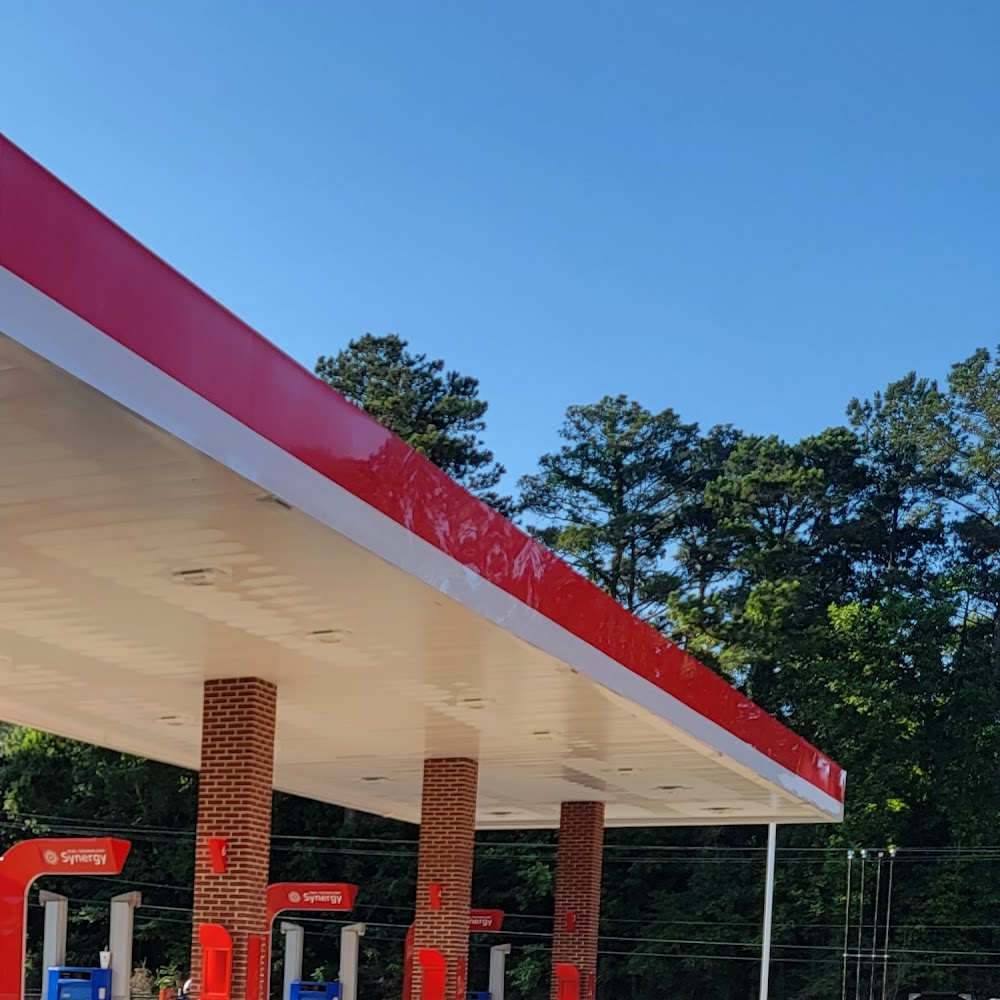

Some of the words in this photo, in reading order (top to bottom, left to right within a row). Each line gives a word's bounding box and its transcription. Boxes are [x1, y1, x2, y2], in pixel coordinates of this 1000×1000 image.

[60, 851, 107, 866] Synergy
[302, 892, 343, 905] Synergy
[470, 919, 493, 927] nergy
